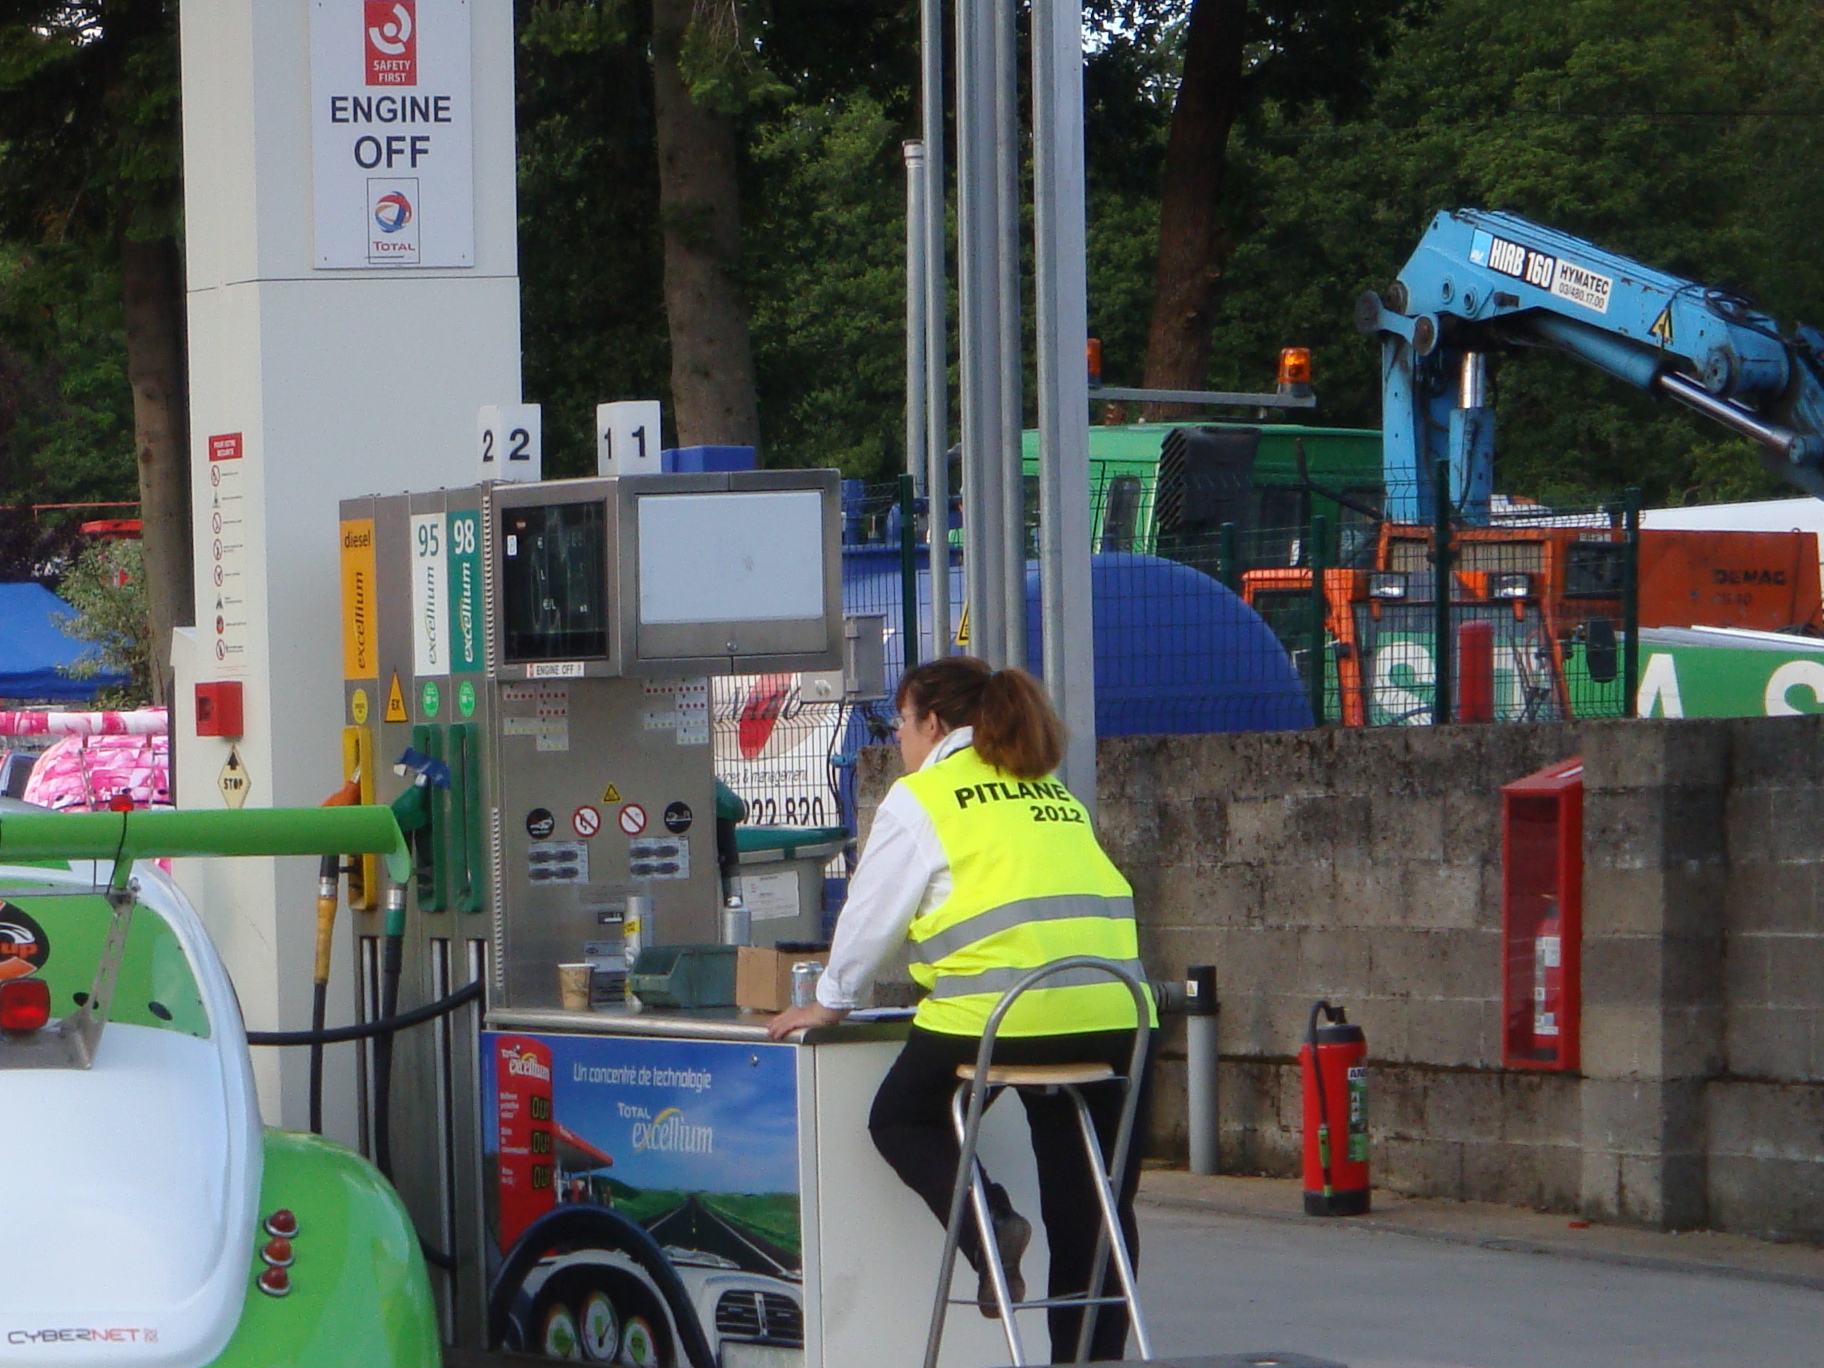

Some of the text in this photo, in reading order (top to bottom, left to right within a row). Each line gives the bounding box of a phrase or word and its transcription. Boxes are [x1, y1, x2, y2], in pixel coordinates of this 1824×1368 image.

[373, 60, 411, 71] SAFETY
[379, 73, 407, 83] FIRST
[331, 96, 452, 123] ENGINE
[354, 135, 430, 169] OFF
[1489, 237, 1554, 288] HIAB 160
[1560, 265, 1609, 295] HYMATEC
[482, 429, 494, 462] 2
[509, 428, 530, 460] 2
[604, 427, 612, 460] 1
[631, 425, 646, 458] 1
[344, 529, 371, 548] diesel
[418, 524, 439, 557] 95
[454, 519, 475, 554] 98
[1711, 569, 1787, 586] DEMAG
[354, 572, 366, 669] excellium
[426, 566, 438, 665] excellium
[462, 562, 474, 663] excellium
[223, 778, 243, 790] STOP
[954, 782, 1070, 809] PITLANE
[1030, 805, 1085, 824] 2012
[573, 1063, 712, 1093] Un concentré de technologie
[632, 1115, 713, 1153] excellium
[7, 1328, 140, 1344] CYBERNET
